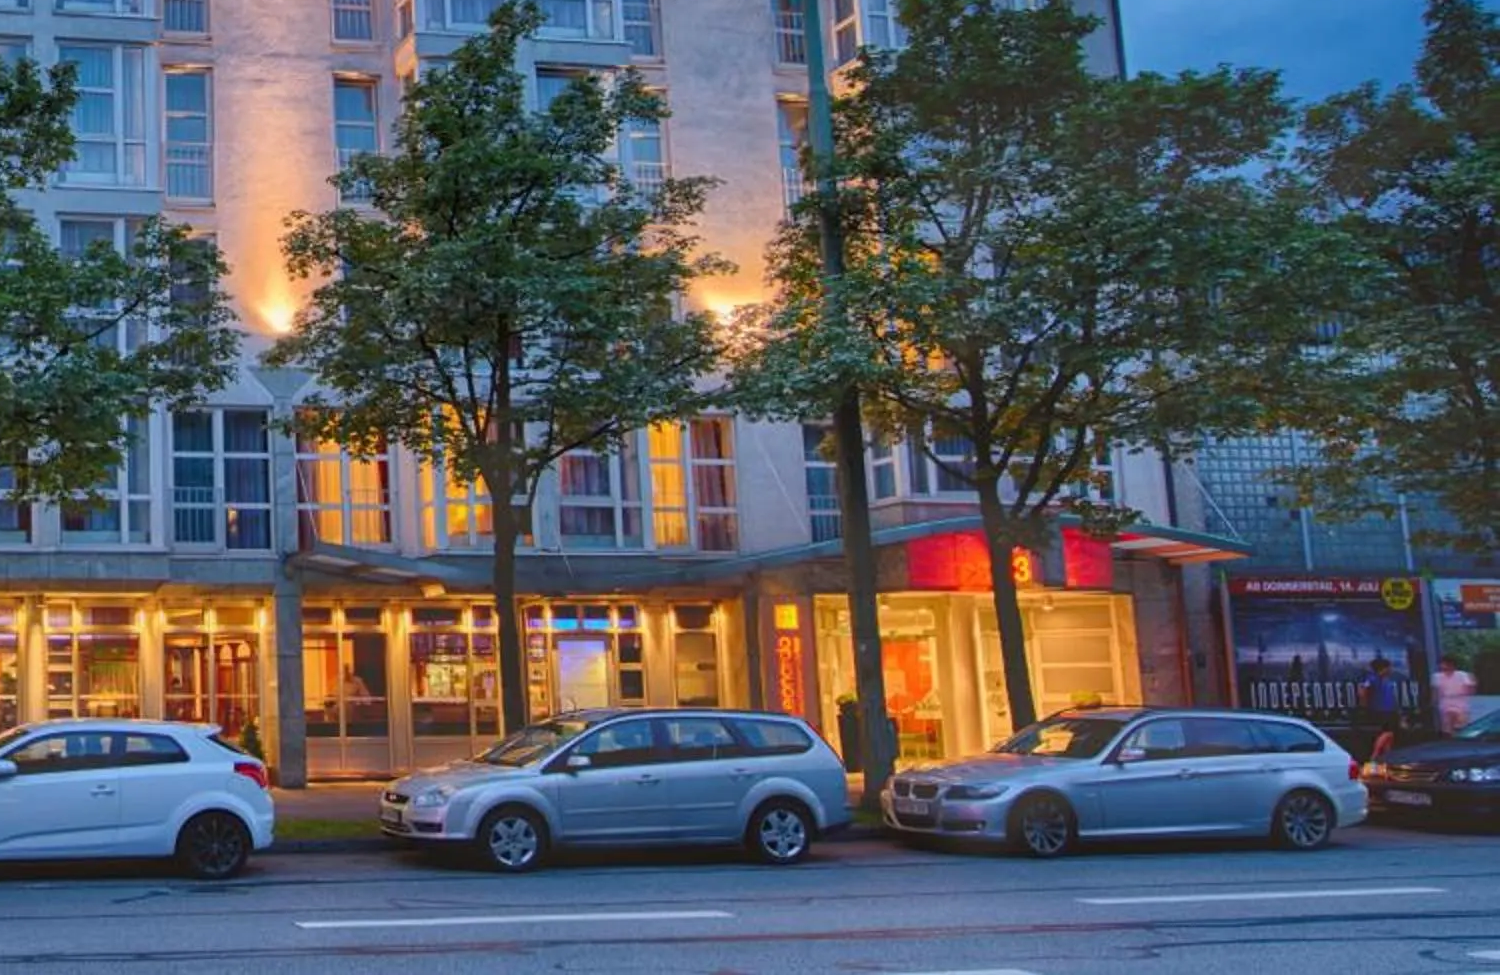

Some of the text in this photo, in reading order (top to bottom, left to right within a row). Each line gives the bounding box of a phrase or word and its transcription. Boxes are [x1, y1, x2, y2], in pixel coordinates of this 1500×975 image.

[1245, 579, 1261, 593] AB
[775, 636, 794, 712] eonardo
[1250, 681, 1368, 710] INDEPENDEN
